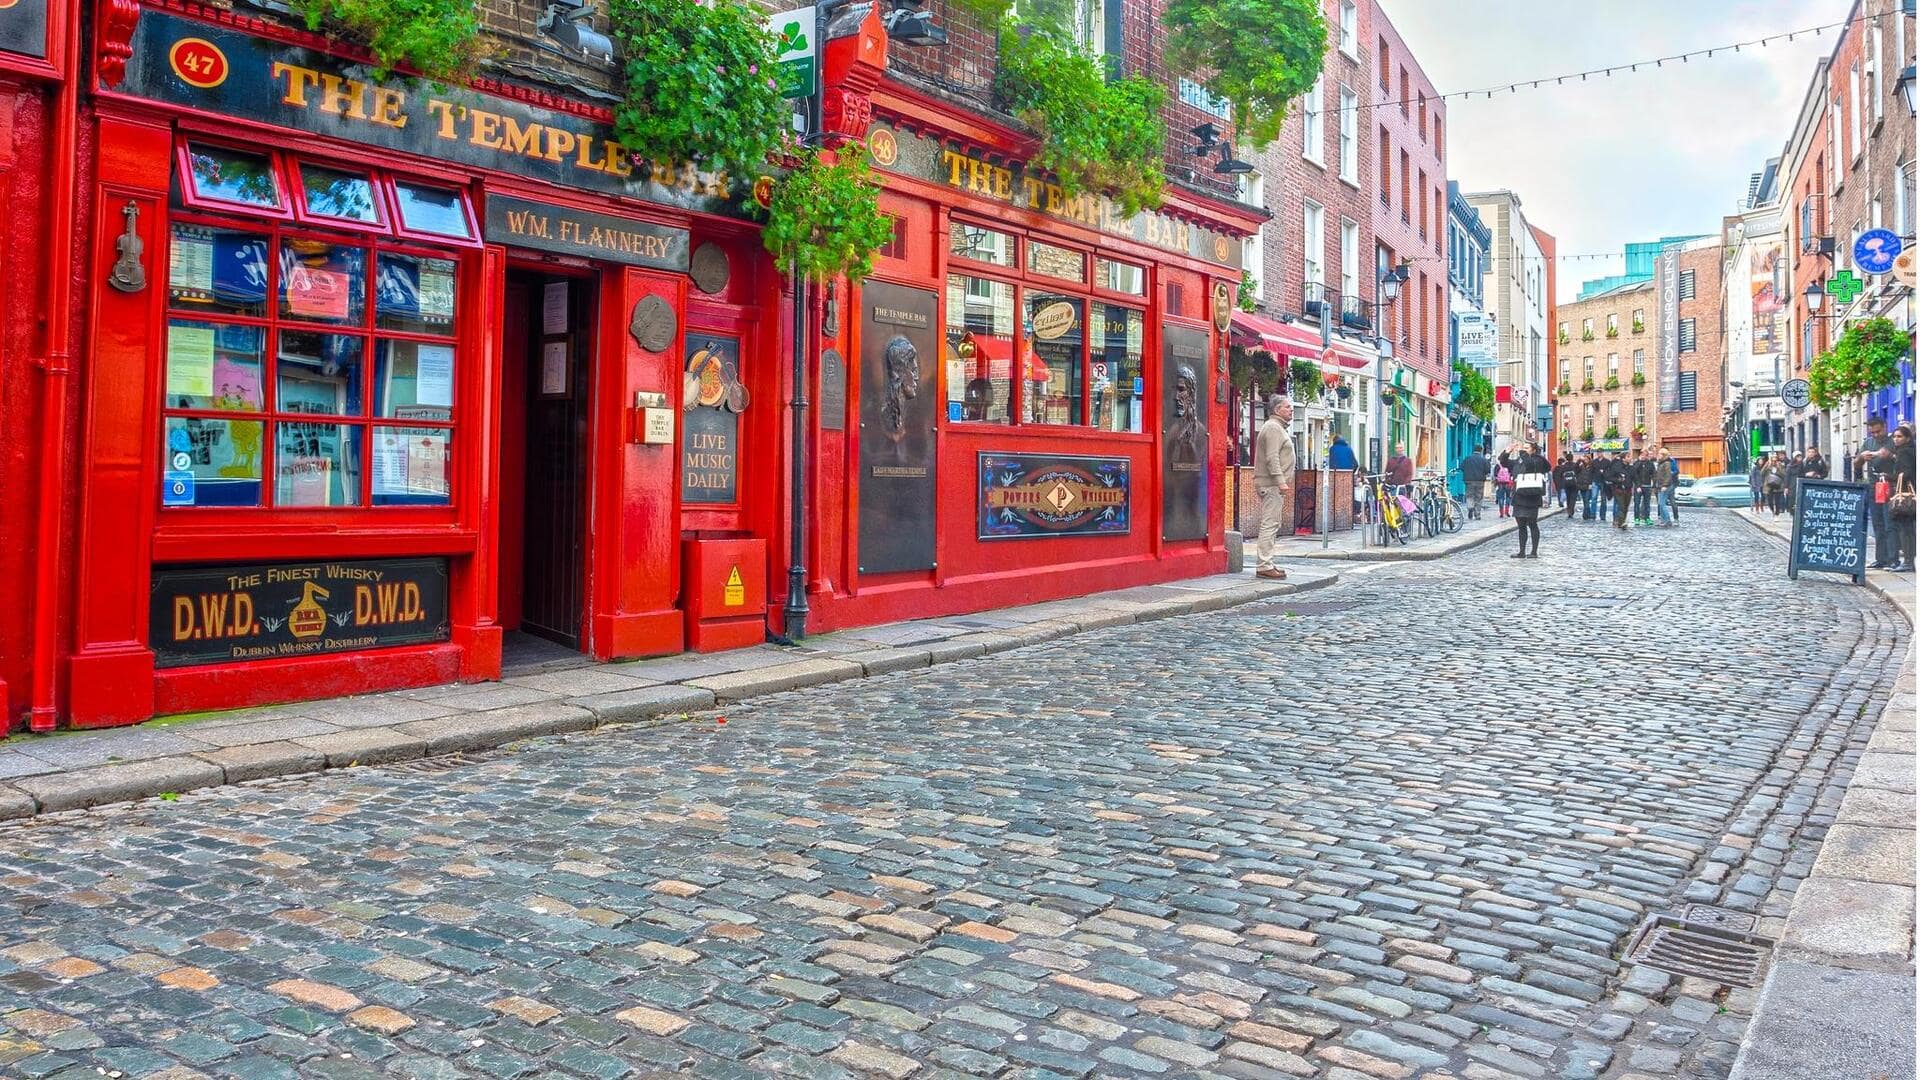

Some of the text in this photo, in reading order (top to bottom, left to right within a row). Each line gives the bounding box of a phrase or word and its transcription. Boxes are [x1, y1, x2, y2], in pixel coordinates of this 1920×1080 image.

[182, 49, 216, 76] 47
[272, 61, 408, 129] THE
[428, 100, 634, 178] TEMPLE
[873, 140, 892, 160] 48
[943, 149, 1191, 254] THE TEMPLE BAR
[507, 209, 674, 259] WM. FLANNERY
[1664, 248, 1674, 331] ENROLLING
[874, 307, 889, 317] THE
[890, 309, 913, 321] TEMPLE
[1461, 332, 1484, 340] LIVE
[1664, 338, 1674, 373] NOW
[692, 433, 727, 450] LIVE
[687, 452, 732, 470] MUSIC
[687, 472, 730, 489] DAILY
[1003, 490, 1041, 504] POWERS
[1081, 489, 1118, 503] WHISKEY
[1813, 500, 1857, 511] Lunch Deal
[1804, 510, 1831, 519] Starter
[1837, 511, 1857, 521] Main
[1831, 527, 1852, 538] drink
[227, 564, 384, 591] THE FINEST WHISKY
[174, 582, 426, 641] D.W.D. D.W.D.
[324, 636, 378, 649] DISTILLERY
